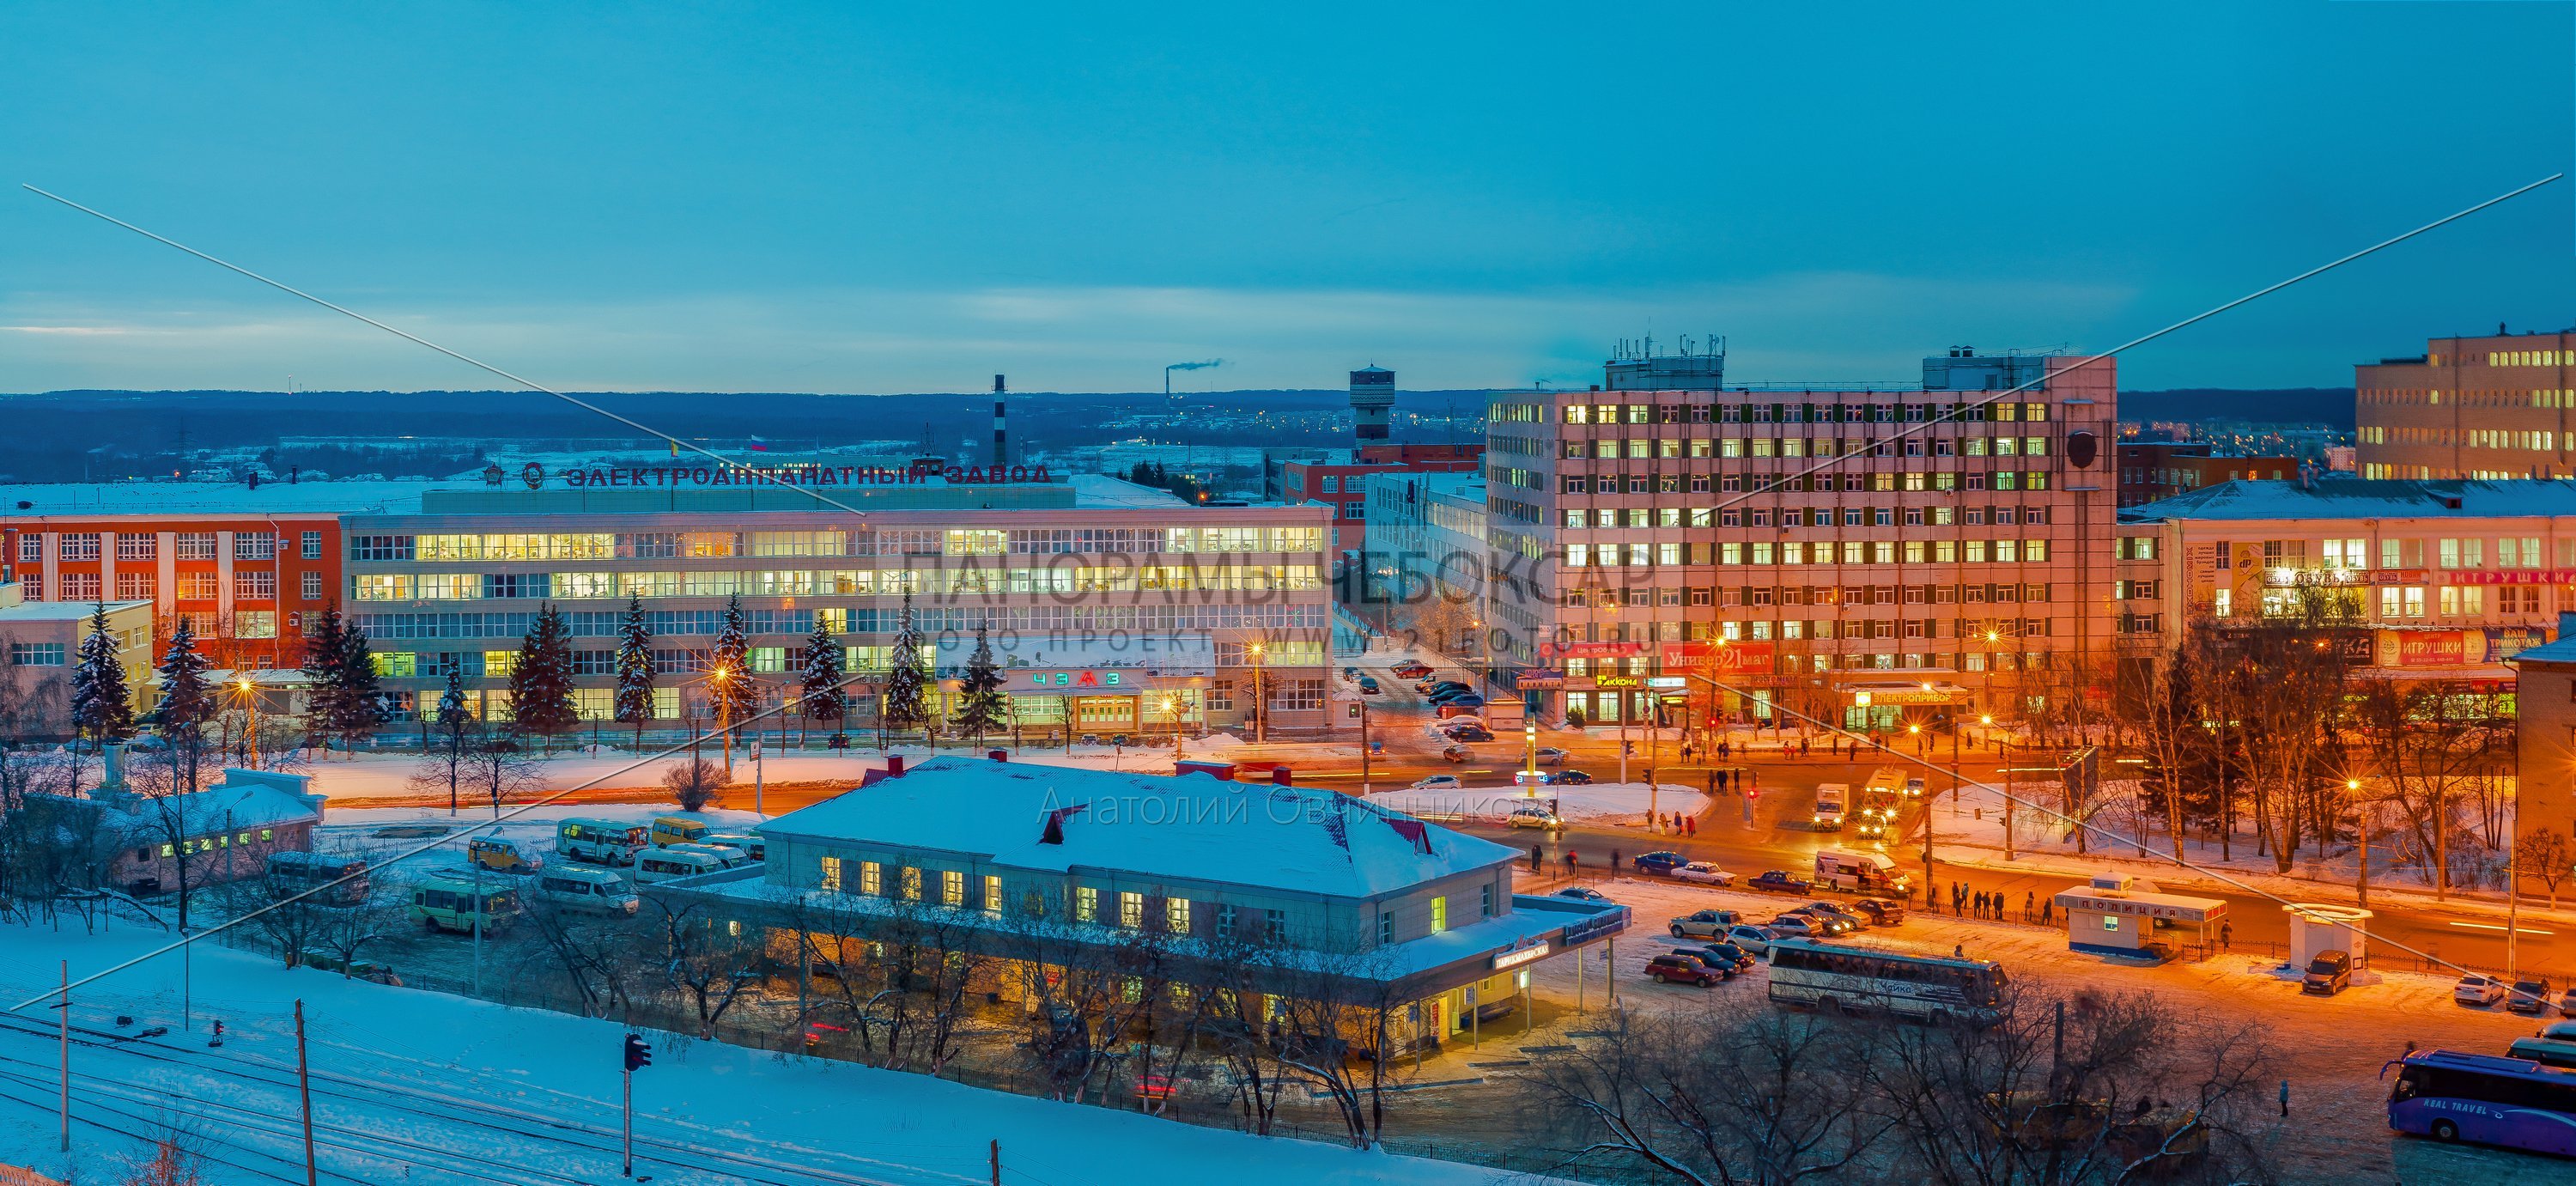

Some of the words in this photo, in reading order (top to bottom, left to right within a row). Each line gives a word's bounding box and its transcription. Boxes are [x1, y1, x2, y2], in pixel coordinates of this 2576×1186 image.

[566, 465, 927, 485] ЭЛЕКТРОАППАРАТНЫЙ
[945, 465, 1053, 485] ЗАВОД
[2457, 572, 2565, 584] ИГРУШКИ
[2504, 629, 2528, 638] ВАШ
[2403, 642, 2462, 654] ИГРУШКИ
[2490, 638, 2542, 648] ТРИКОТАЖ
[1874, 693, 1952, 703] ЭЛЕКТРОПРИБОР
[2082, 900, 2176, 917] ПОЛИЦИЯ
[1497, 945, 1549, 969] ПАРИКМАХЕРСКАЯ
[2424, 1098, 2446, 1109] REAL
[2452, 1103, 2487, 1114] TRAVEL
